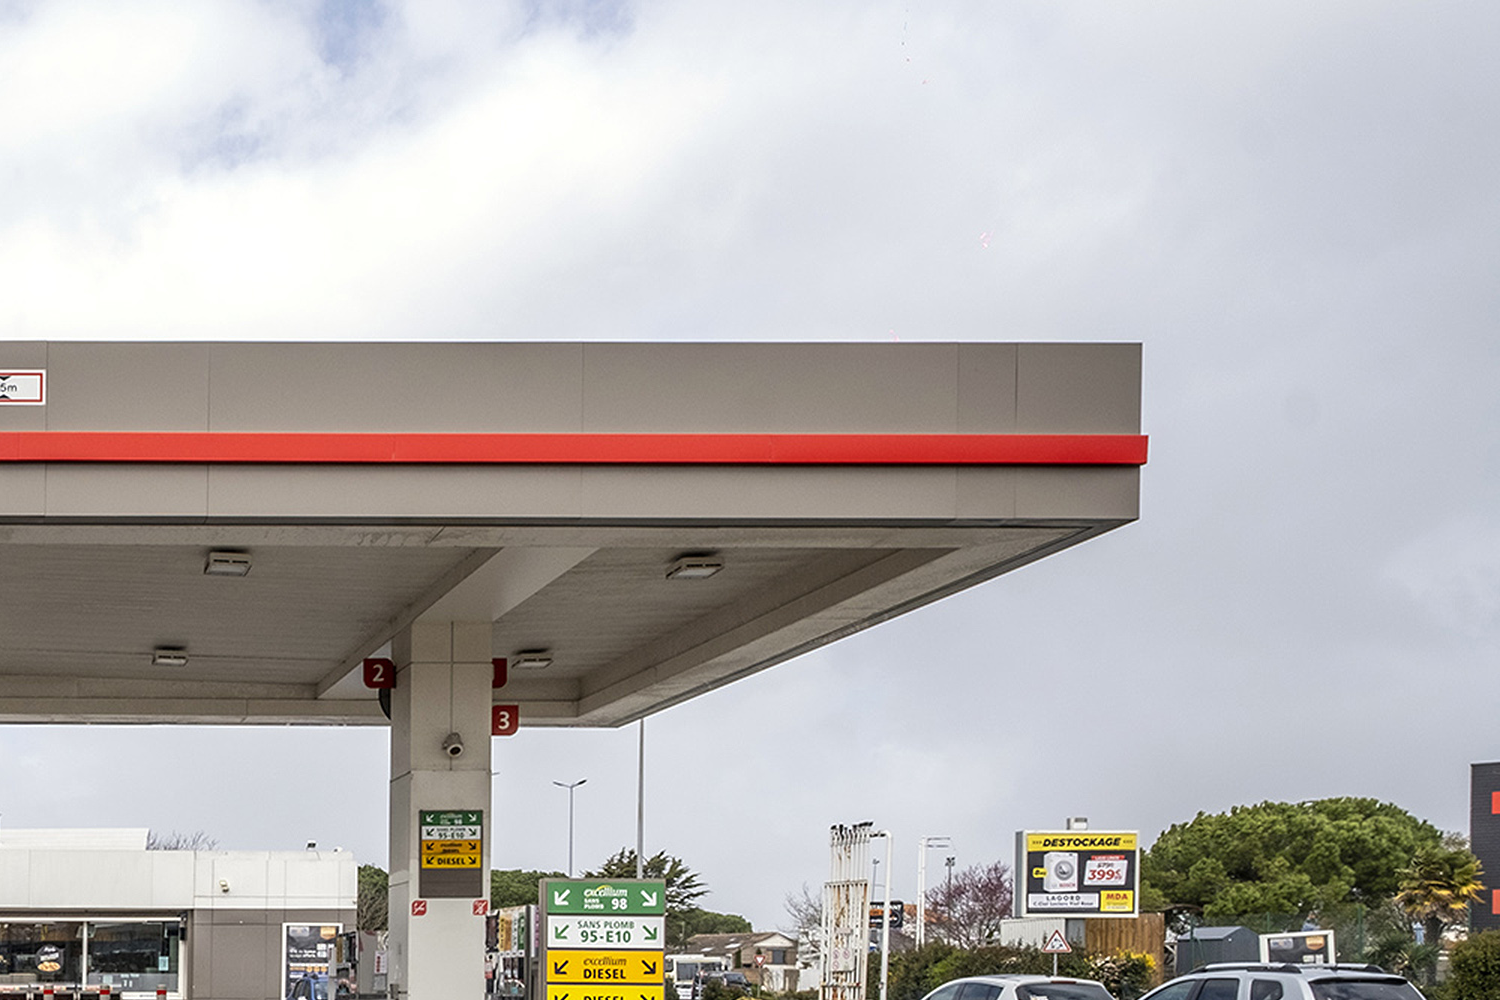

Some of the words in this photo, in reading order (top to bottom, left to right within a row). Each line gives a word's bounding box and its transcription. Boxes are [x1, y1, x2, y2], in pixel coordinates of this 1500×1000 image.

[372, 663, 385, 682] 2
[498, 711, 511, 730] 3
[1043, 837, 1122, 847] DESTOCKAGE
[583, 887, 628, 897] excellium
[611, 898, 628, 910] 98
[577, 920, 601, 929] SANS
[604, 920, 635, 929] PLOMB
[580, 930, 632, 943] 95-E10
[583, 956, 627, 966] excellium
[583, 968, 627, 979] DIESEL
